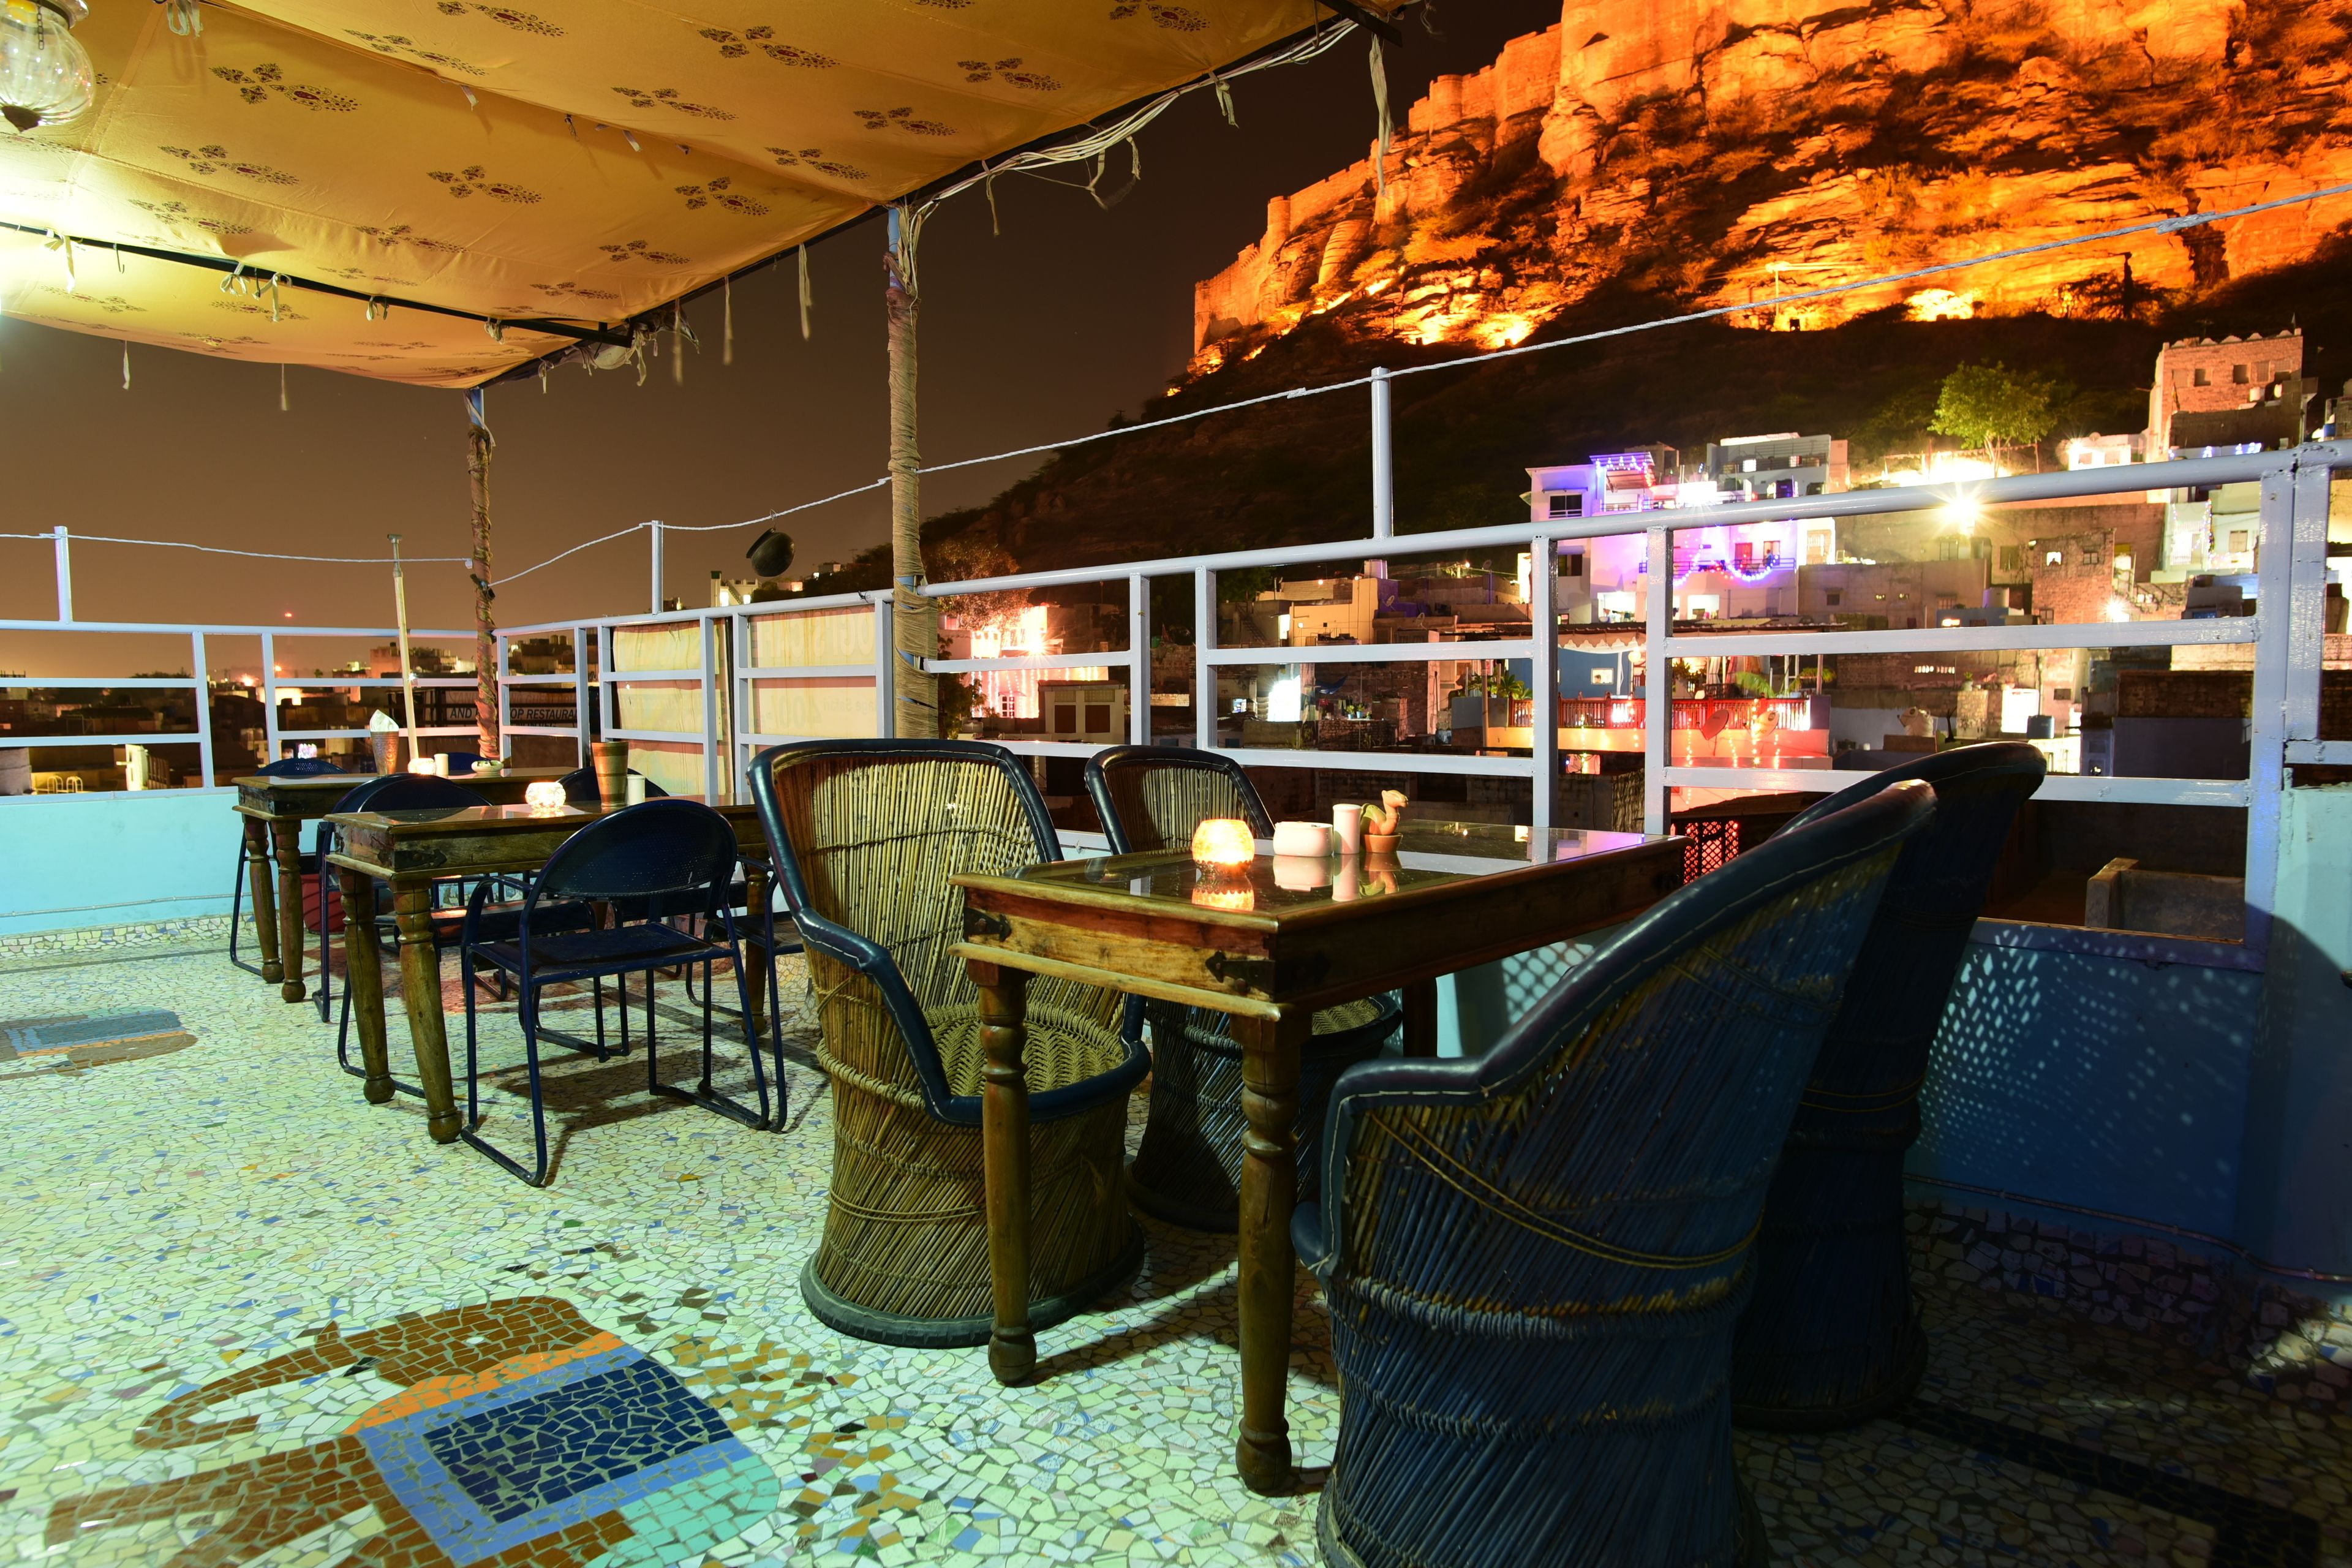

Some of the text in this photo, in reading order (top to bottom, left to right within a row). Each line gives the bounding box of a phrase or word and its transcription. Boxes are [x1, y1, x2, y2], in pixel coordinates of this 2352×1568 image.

[450, 706, 577, 720] AND OP RESTAURA
